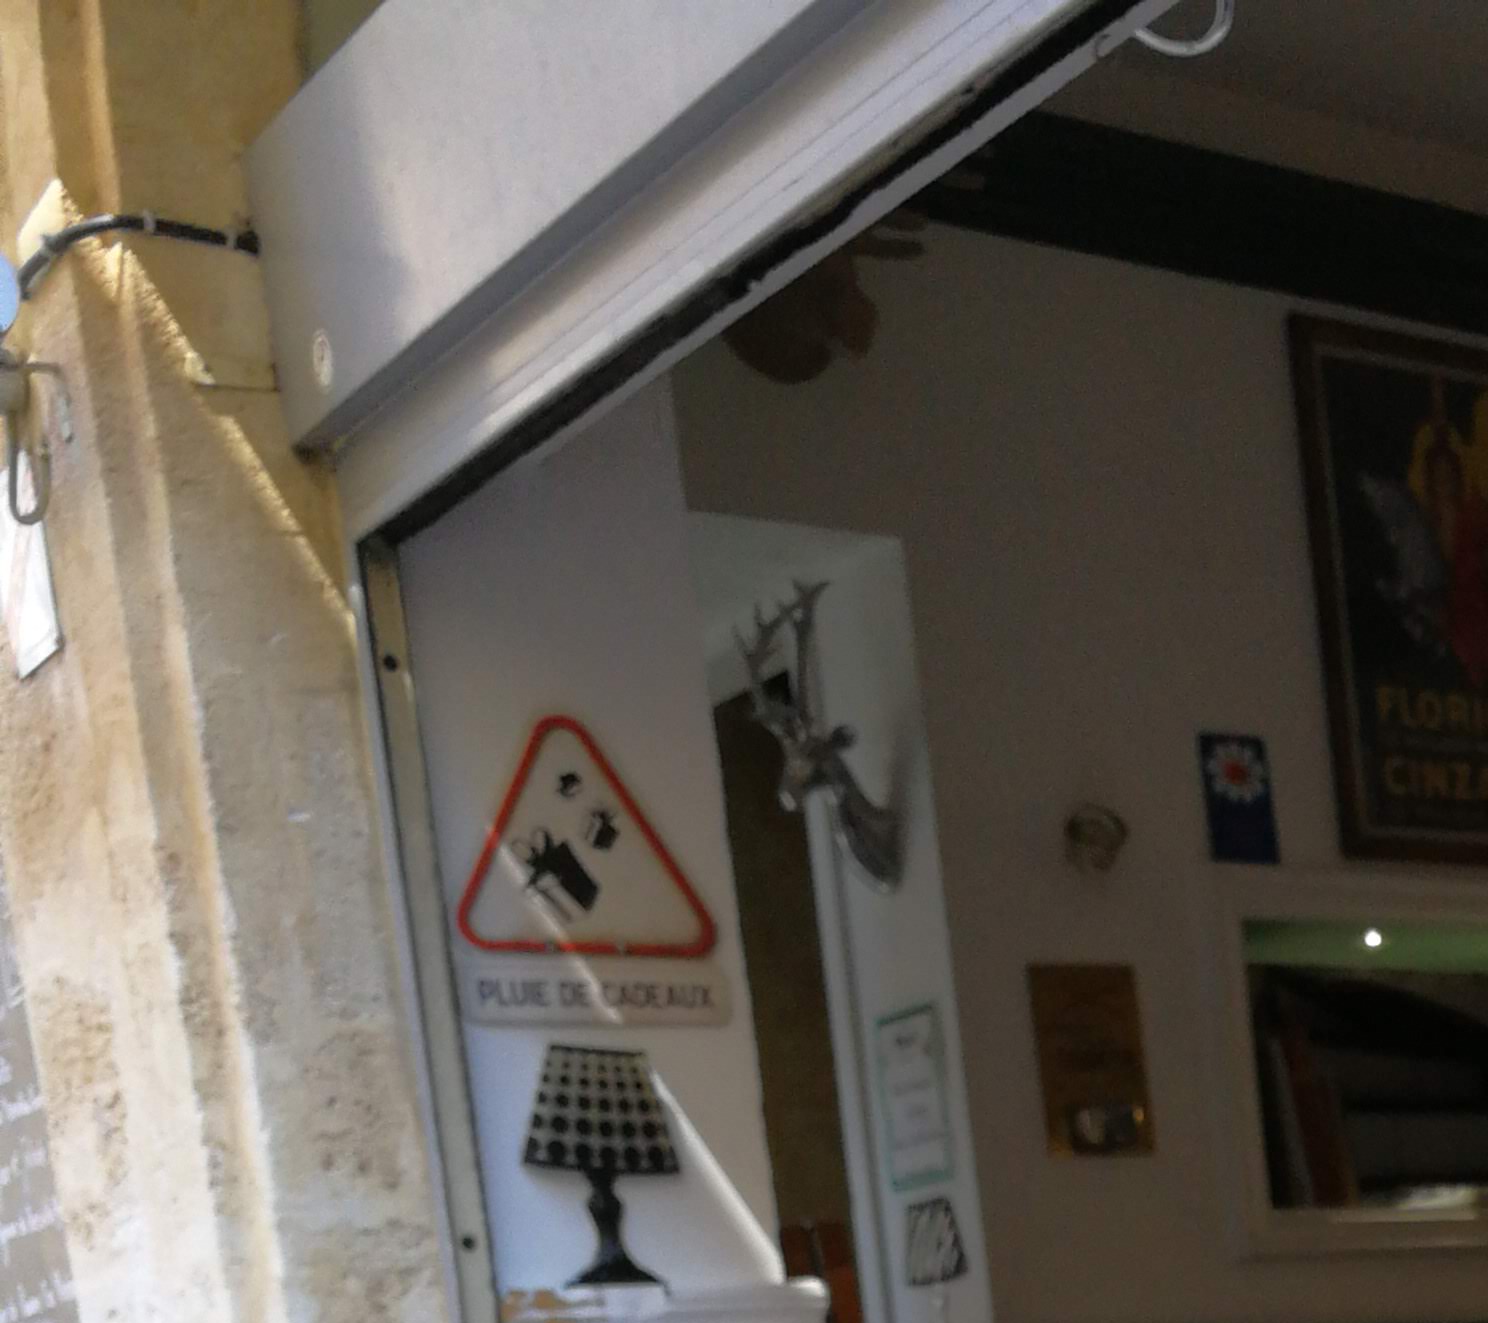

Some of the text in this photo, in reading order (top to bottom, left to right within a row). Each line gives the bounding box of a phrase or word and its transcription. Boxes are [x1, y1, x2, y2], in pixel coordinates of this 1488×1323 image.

[477, 979, 716, 1011] PLUIE DE CADEAUX
